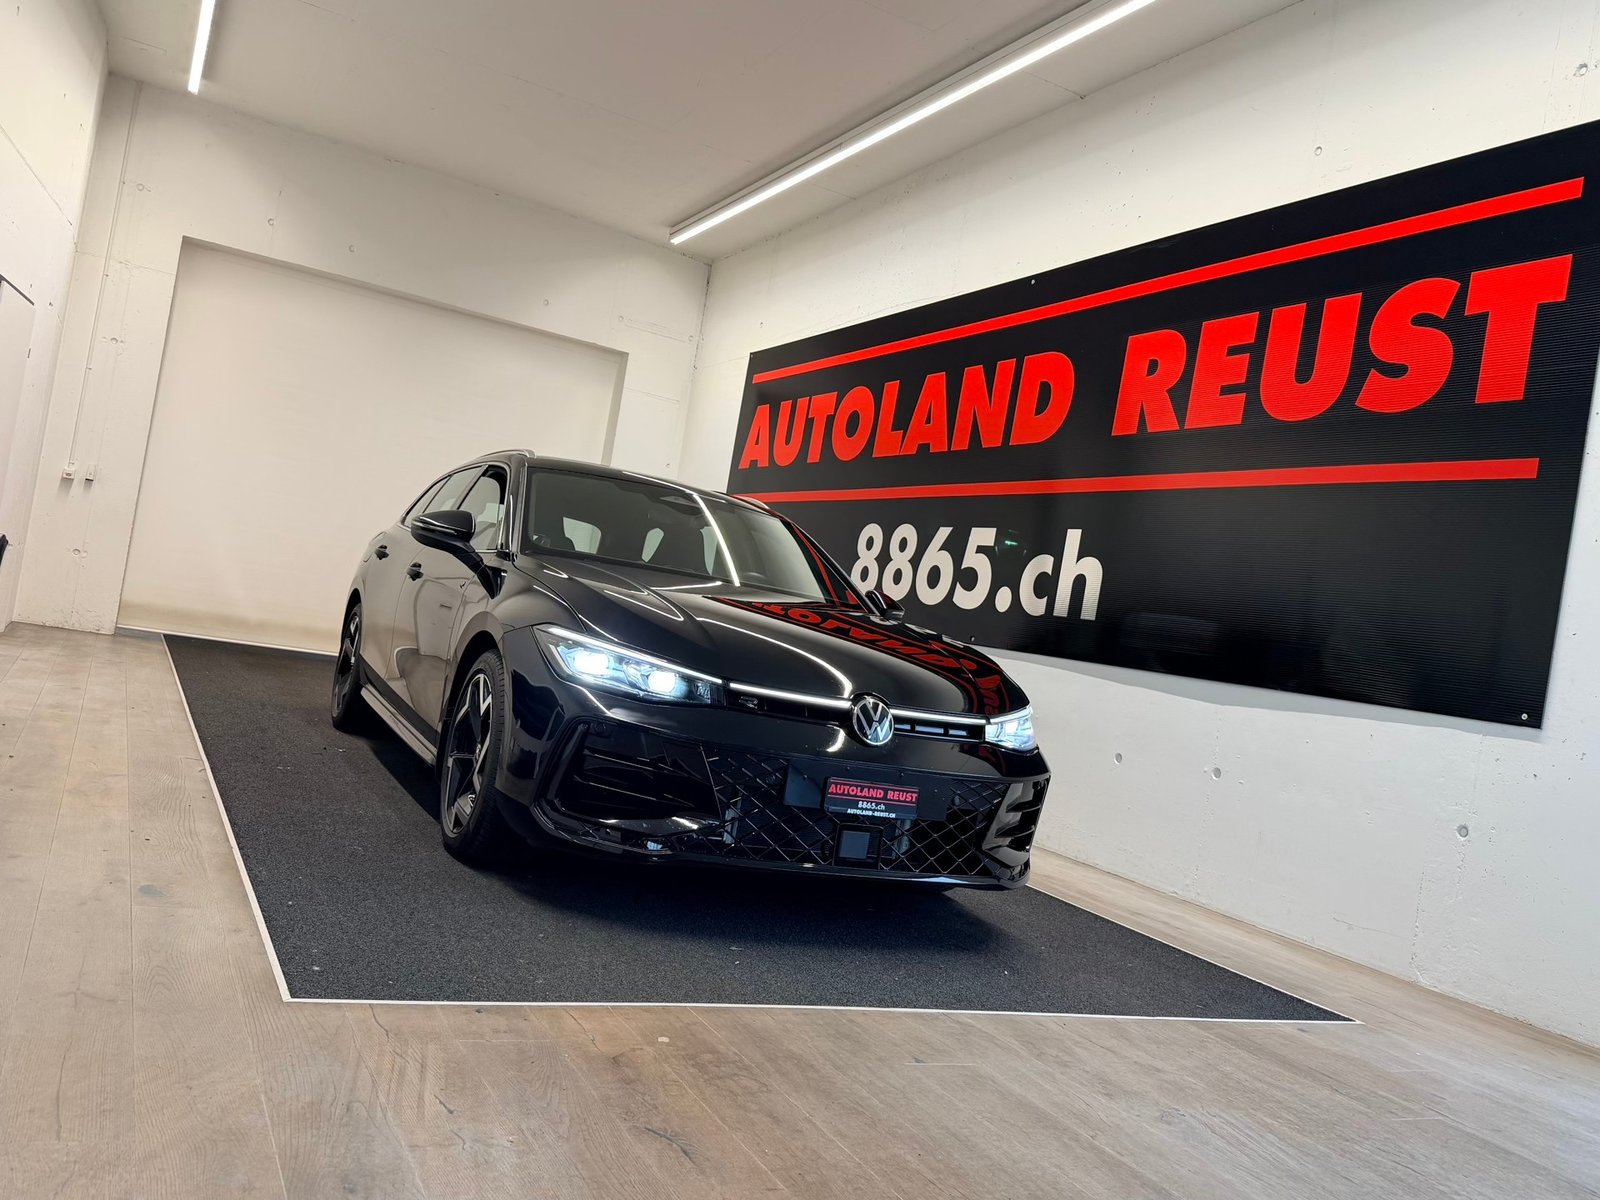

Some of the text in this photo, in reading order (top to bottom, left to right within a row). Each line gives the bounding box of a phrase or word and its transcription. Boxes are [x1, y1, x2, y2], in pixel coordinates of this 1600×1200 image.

[740, 254, 1573, 469] AUTOLAND REUST
[850, 523, 1103, 621] 8865.ch
[829, 784, 918, 802] AUTOLAND REUST
[847, 808, 896, 818] AUTOLAND-REUST.CH
[857, 801, 886, 810] 8865.ch
